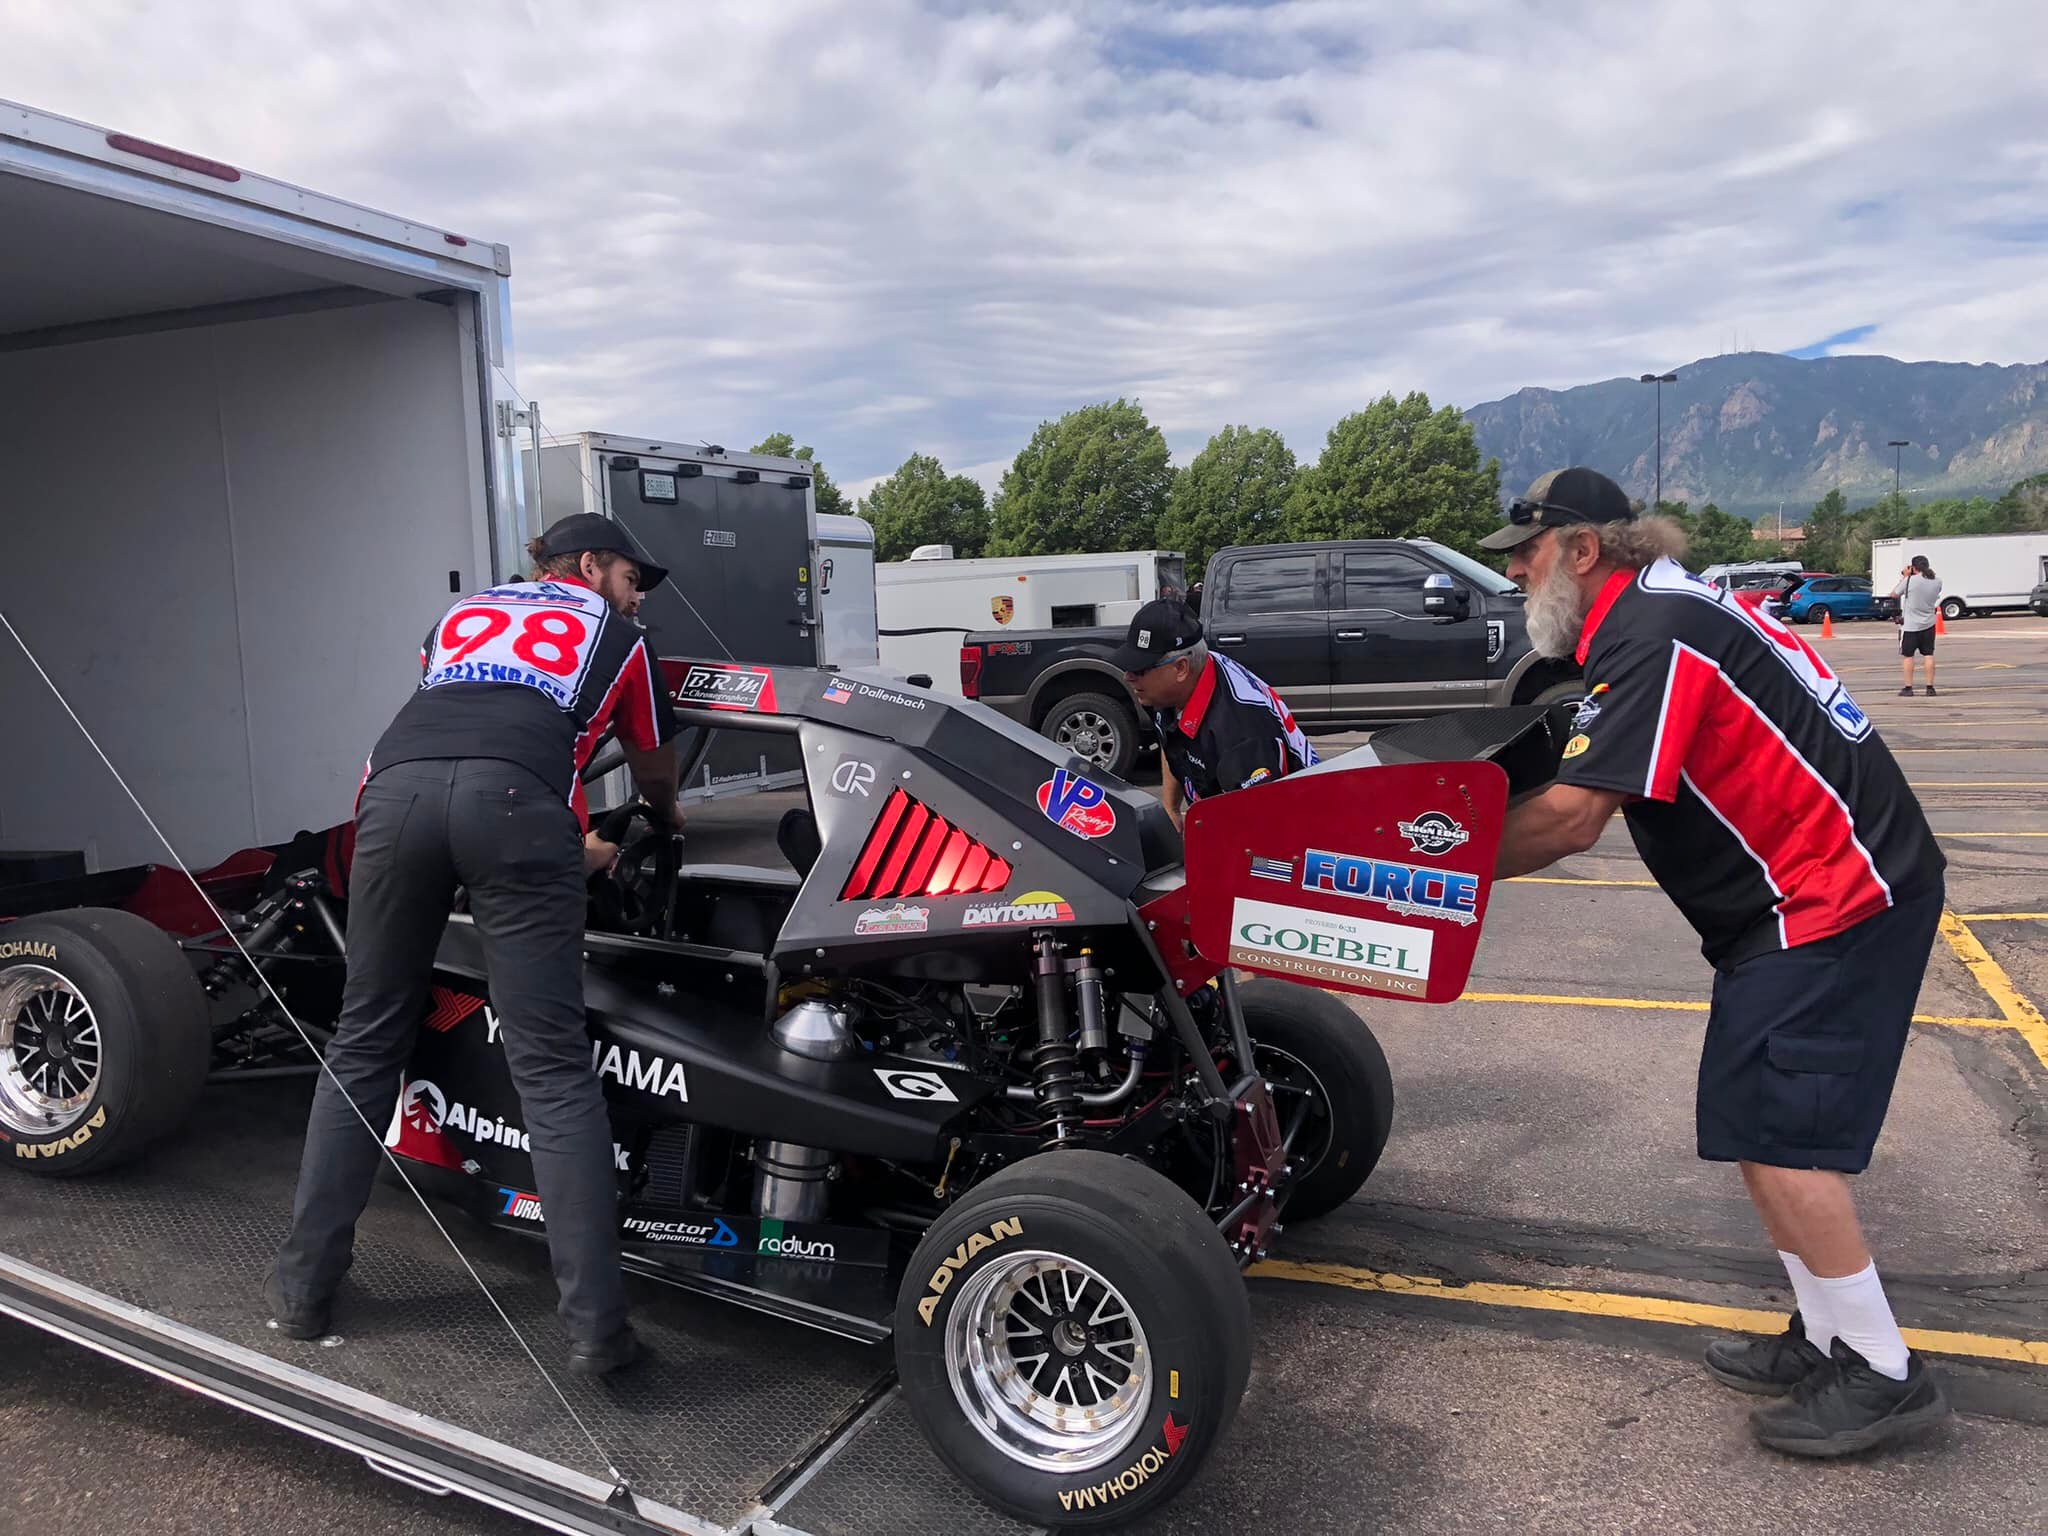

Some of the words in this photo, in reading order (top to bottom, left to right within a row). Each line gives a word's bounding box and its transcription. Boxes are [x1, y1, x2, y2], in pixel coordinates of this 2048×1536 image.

[441, 607, 586, 676] 98
[829, 678, 856, 692] Paul
[858, 685, 926, 711] Dallenbach
[1044, 767, 1105, 824] VP
[1063, 808, 1112, 831] Racing
[1303, 849, 1479, 913] FORCE
[962, 903, 1058, 925] DAYTONA
[1240, 923, 1419, 973] GOEBEL
[1387, 979, 1418, 992] INC
[16, 1104, 107, 1159] ADVAN
[623, 1217, 713, 1236] Injector
[645, 1231, 707, 1245] Dynamics
[759, 1235, 835, 1257] radium
[917, 1215, 1024, 1328] ADVAN
[1058, 1446, 1170, 1511] YOKOHAMA
